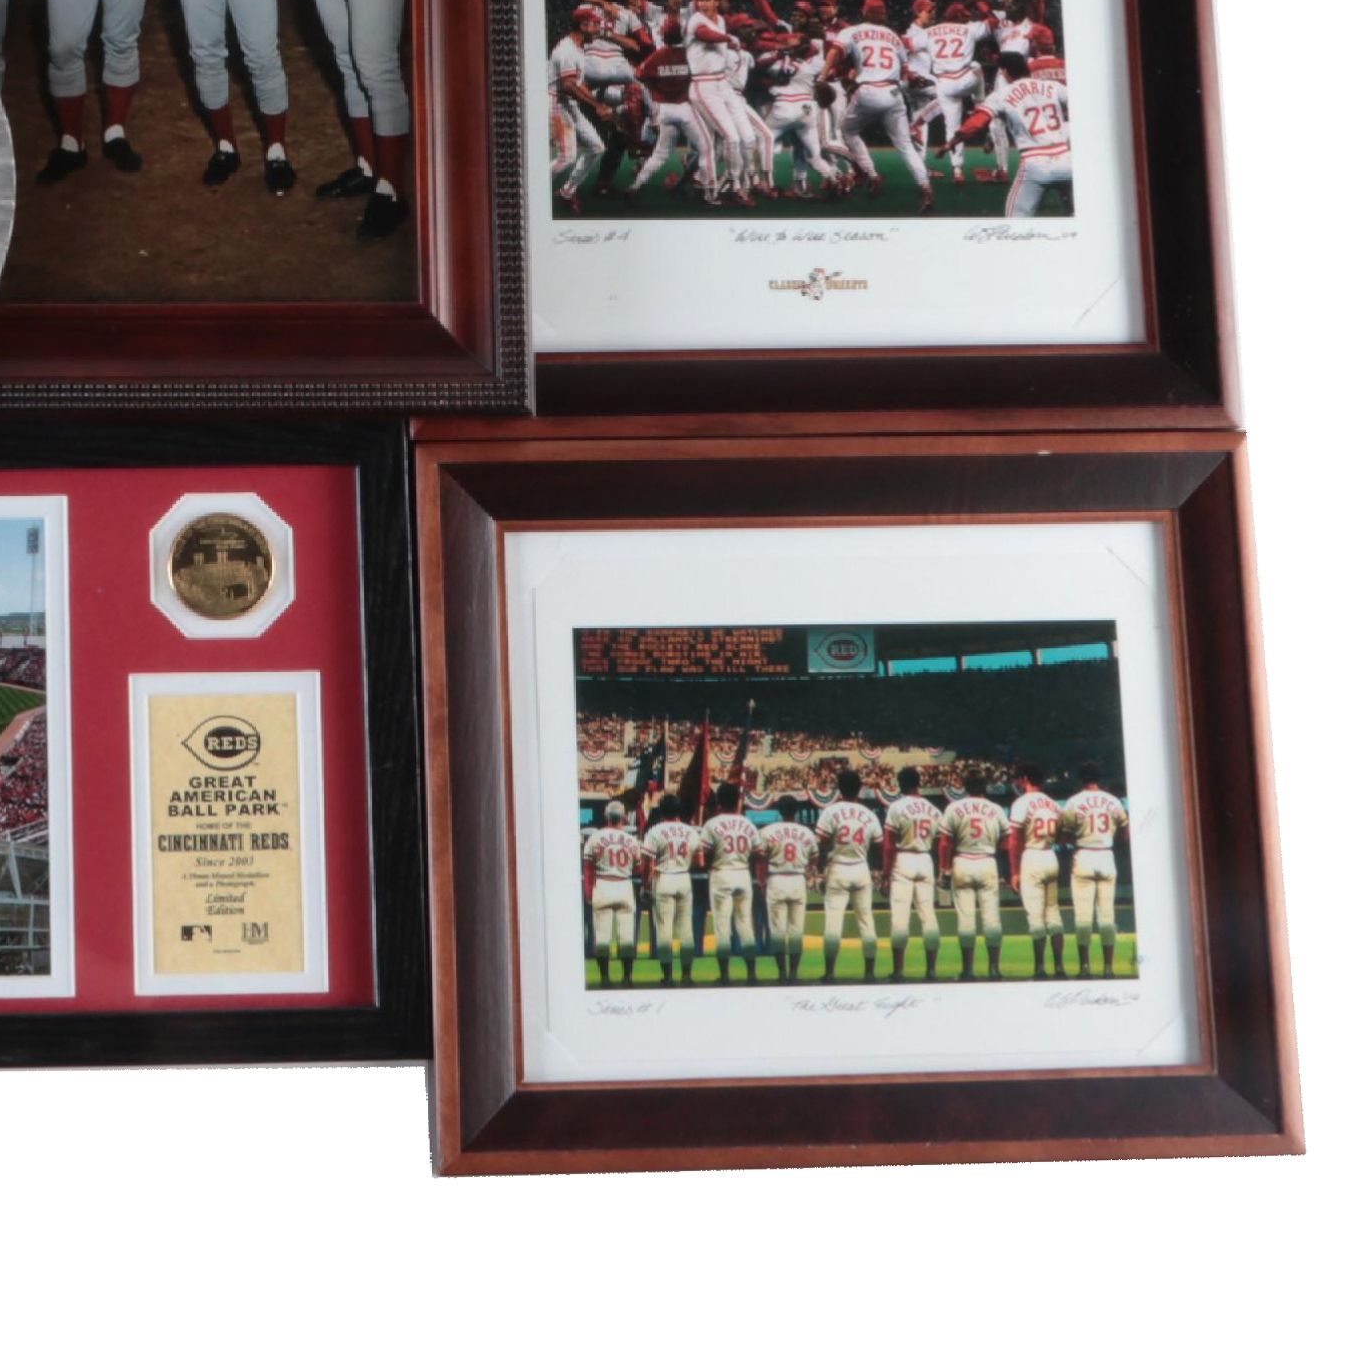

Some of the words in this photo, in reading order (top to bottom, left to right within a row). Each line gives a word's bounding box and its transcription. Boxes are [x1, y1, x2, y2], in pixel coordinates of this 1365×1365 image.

[861, 46, 893, 70] 25
[934, 38, 965, 59] 22
[1005, 82, 1054, 107] MORRIS
[1024, 103, 1061, 136] 23
[207, 735, 259, 752] REDS
[189, 775, 257, 789] GREAT
[169, 789, 277, 803] AMERICAN
[168, 804, 218, 817] BALL
[225, 803, 281, 816] PARK
[833, 808, 874, 827] PEREZ
[955, 802, 998, 820] BENCH
[196, 822, 220, 830] HOME
[222, 821, 233, 829] OF
[236, 821, 251, 829] THE
[969, 818, 983, 839] 5
[1087, 813, 1111, 834] 13
[158, 833, 244, 852] CINCINNATI
[250, 832, 289, 851] REDS
[723, 835, 748, 854] 30
[837, 825, 865, 845] 24
[607, 847, 630, 868] 10
[667, 841, 689, 859] 14
[784, 842, 797, 863] 8
